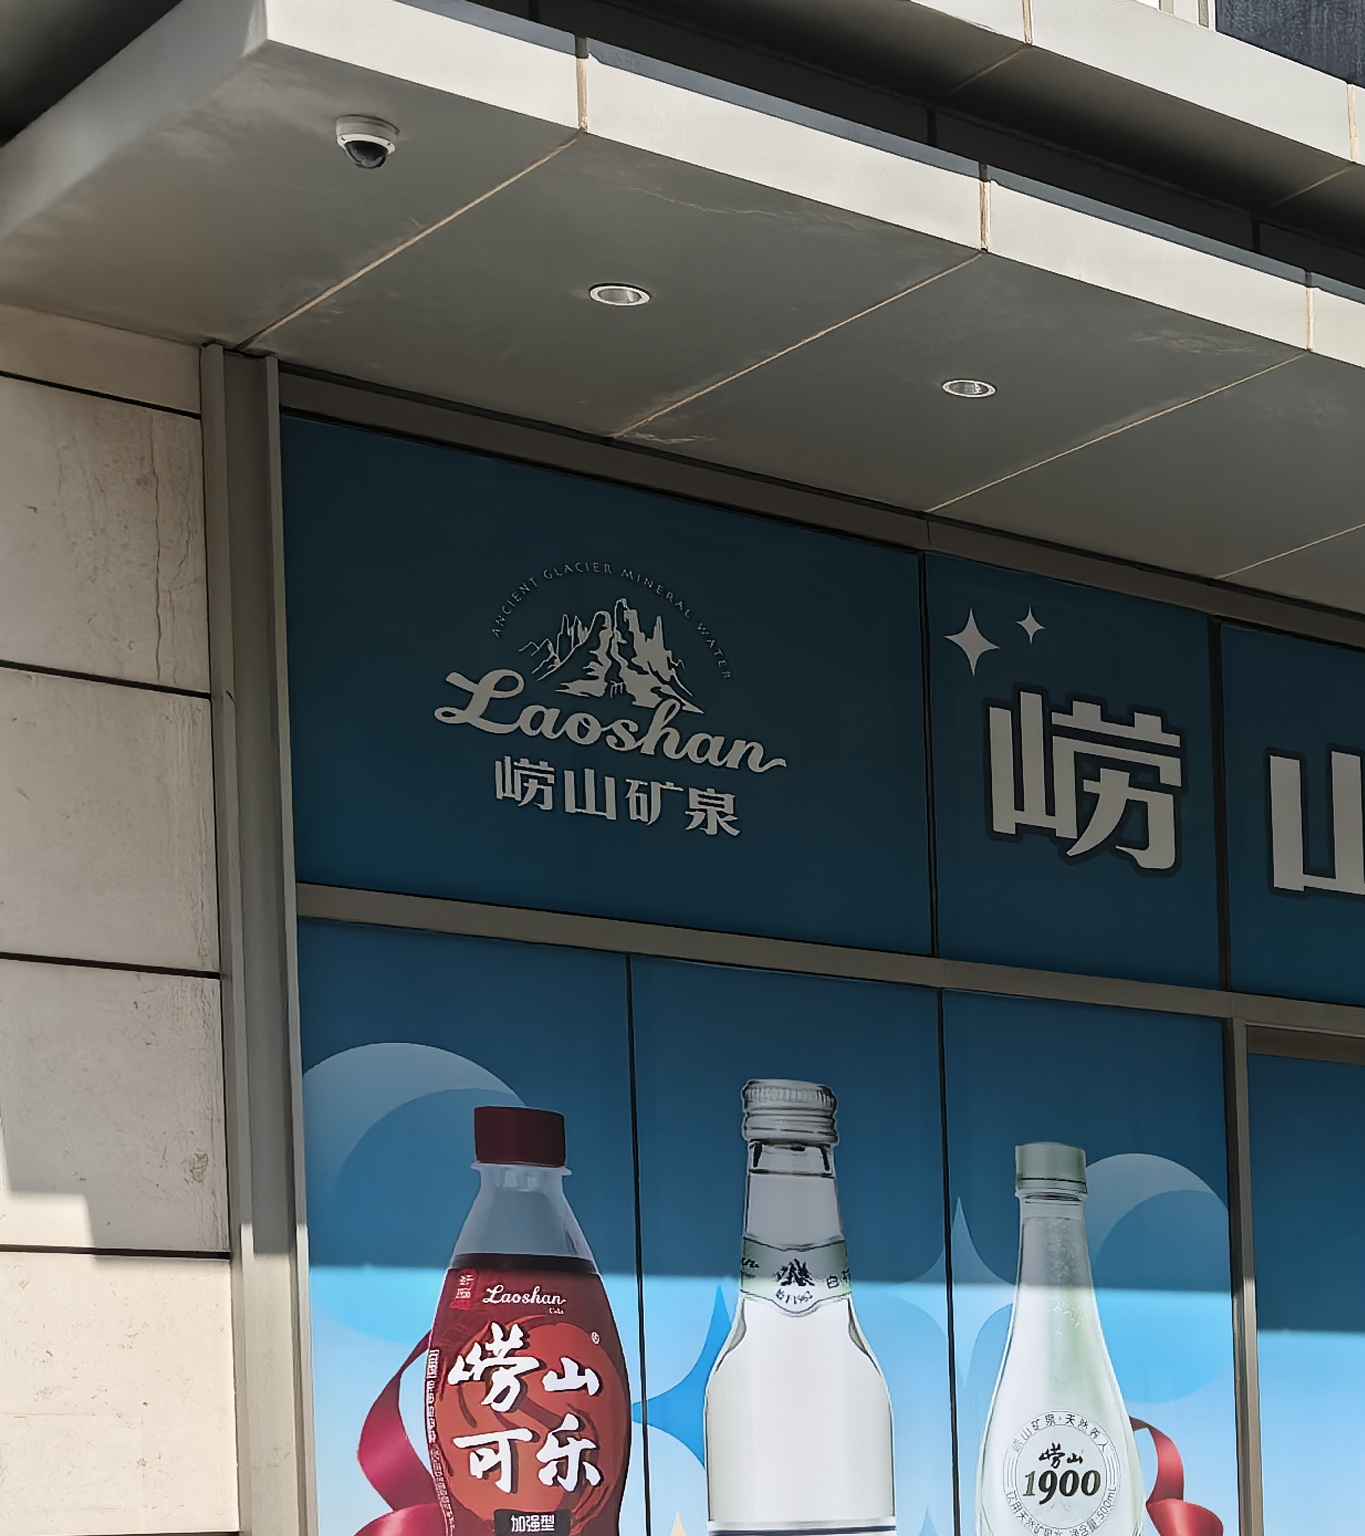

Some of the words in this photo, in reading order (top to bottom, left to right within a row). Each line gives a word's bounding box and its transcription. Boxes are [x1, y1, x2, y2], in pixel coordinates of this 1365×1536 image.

[491, 577, 538, 639] ANCIENT
[543, 561, 612, 581] GLACIER
[621, 568, 690, 619] MINERAL
[434, 669, 787, 773] Laoshan
[494, 755, 741, 837] 崂山矿泉
[482, 1284, 567, 1306] Laoshan
[447, 1322, 600, 1412] 崂山
[452, 1413, 601, 1493] 可乐
[1023, 1470, 1101, 1505] 1900
[1038, 1442, 1084, 1469] 崂山
[511, 1514, 555, 1532] 加强型
